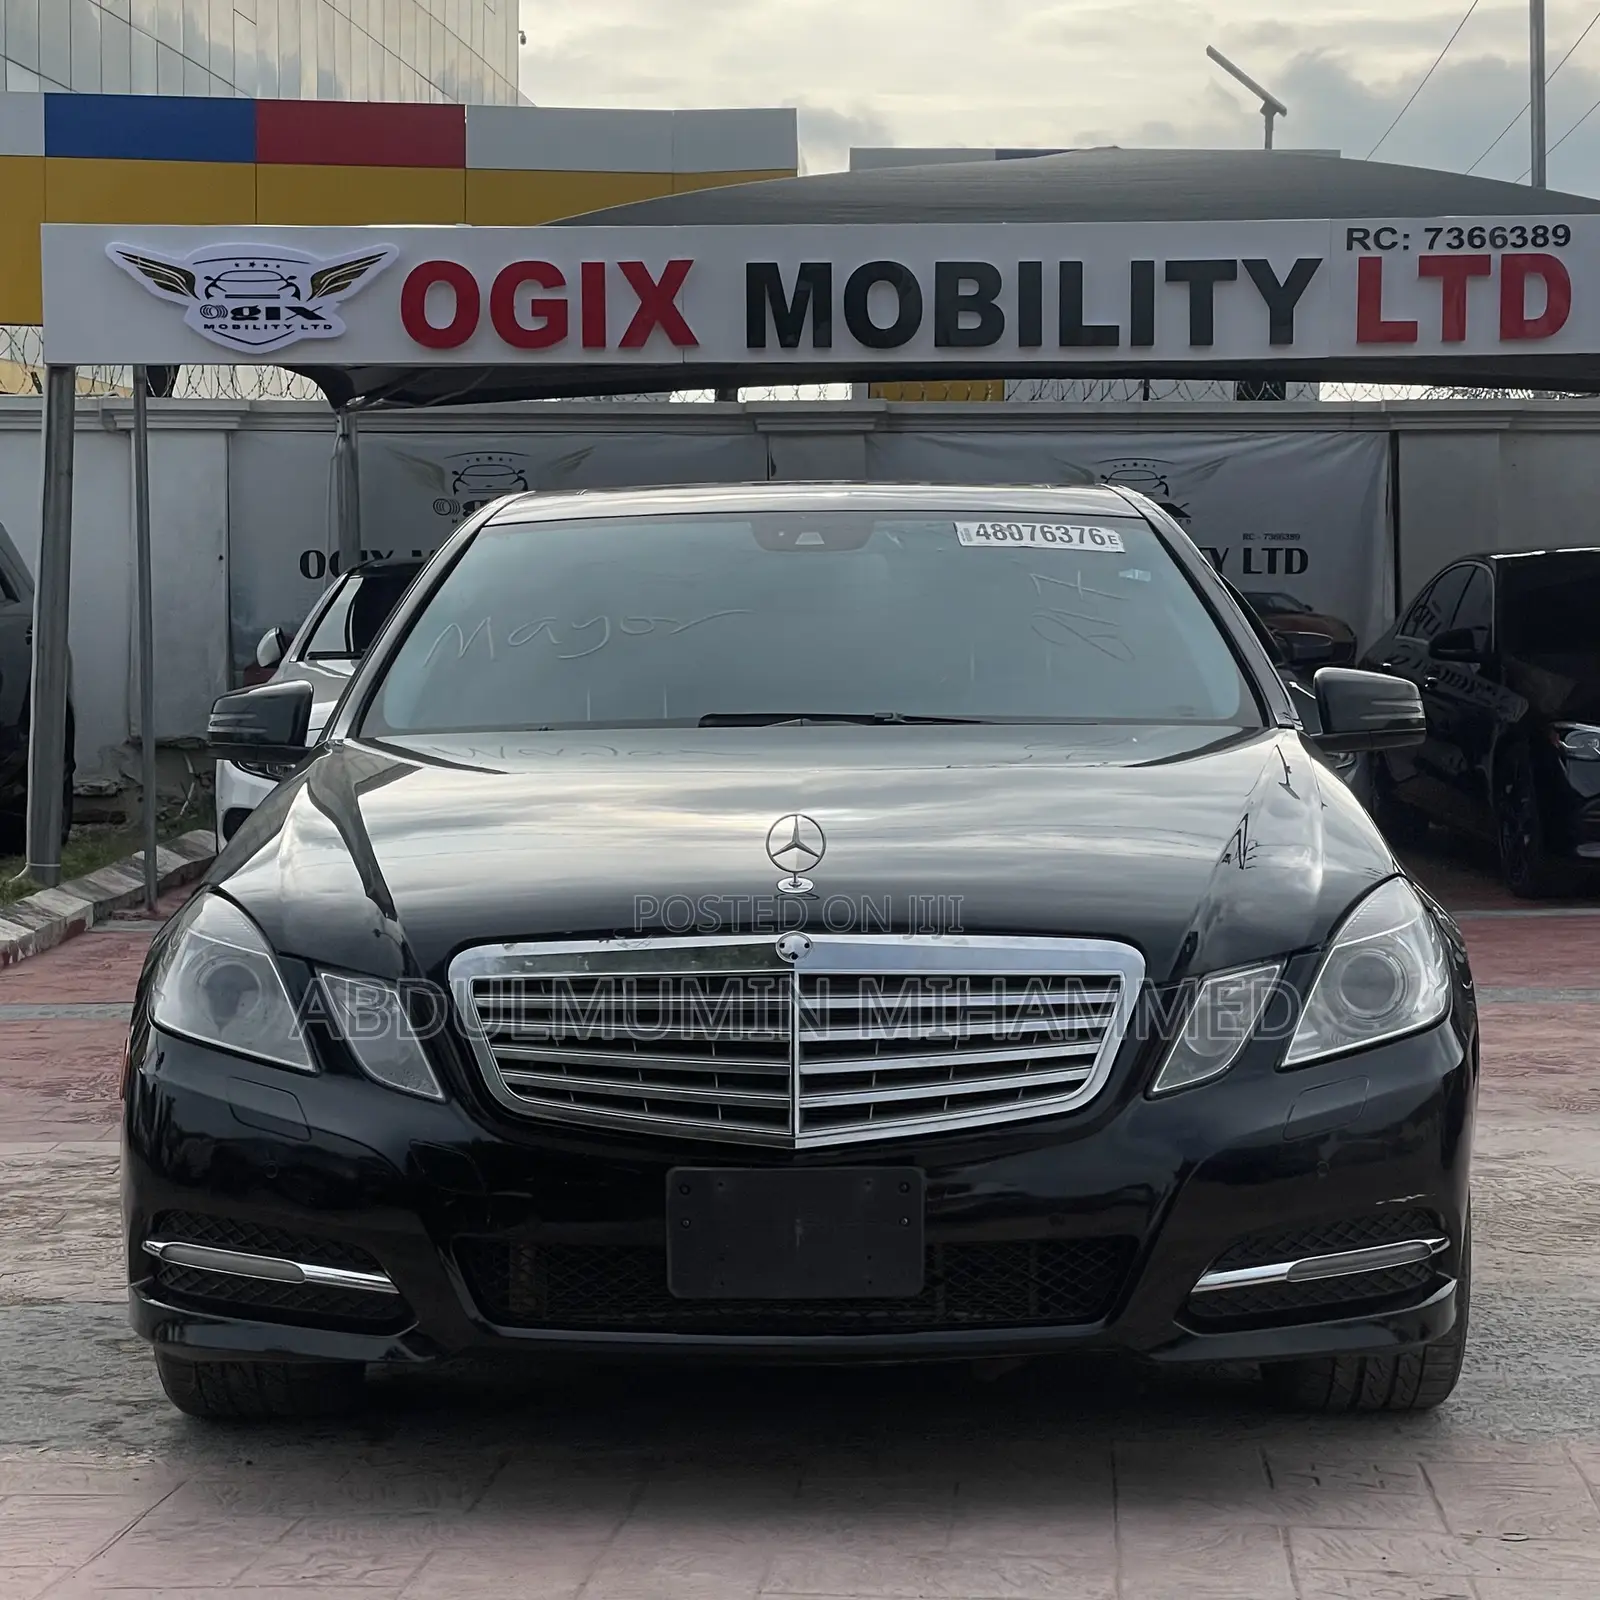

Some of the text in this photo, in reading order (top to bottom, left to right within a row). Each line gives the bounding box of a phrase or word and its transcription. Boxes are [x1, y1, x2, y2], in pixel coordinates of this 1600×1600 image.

[1346, 224, 1571, 250] RC: 7366389
[400, 252, 1572, 349] OGIX MOBILITY LTD
[203, 323, 333, 331] MOBILITY LTD
[975, 523, 1106, 546] 48076376
[1242, 547, 1309, 575] LTD
[423, 609, 757, 668] Mayor
